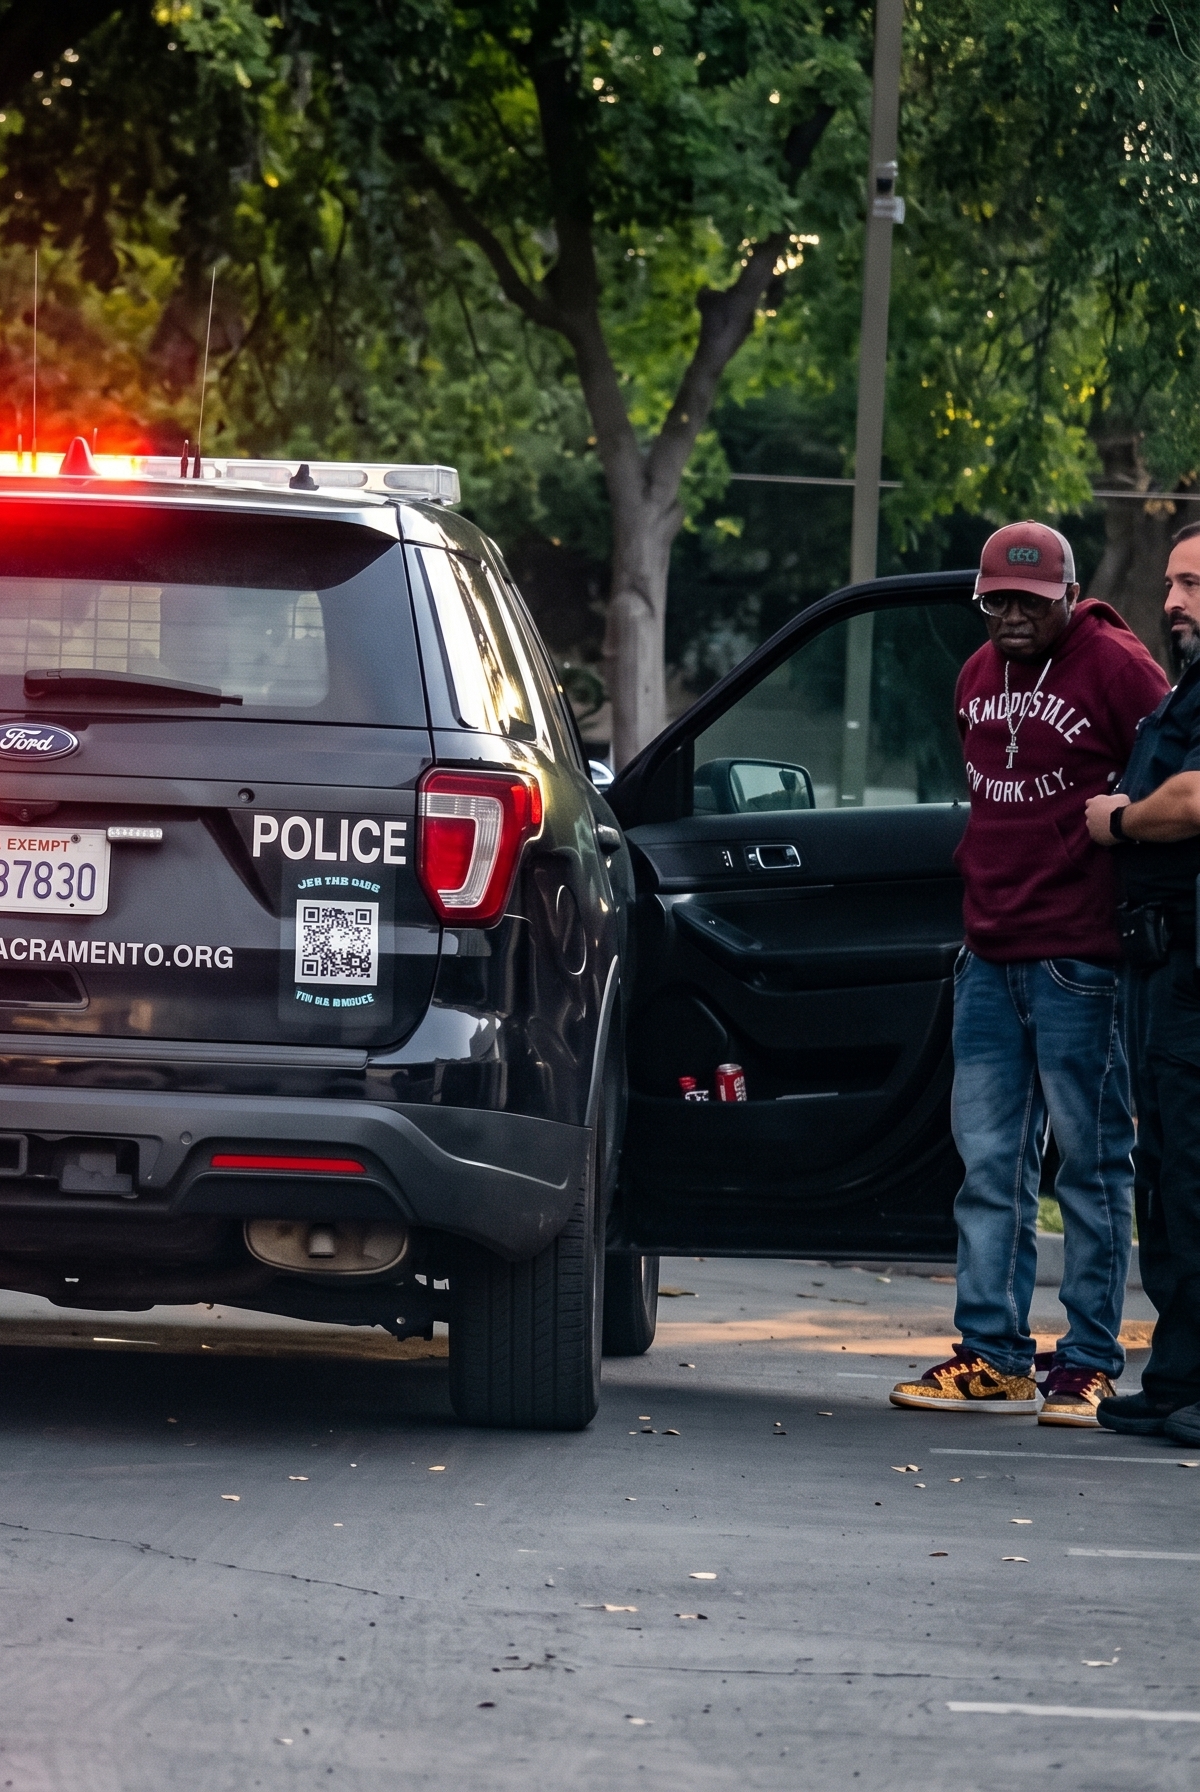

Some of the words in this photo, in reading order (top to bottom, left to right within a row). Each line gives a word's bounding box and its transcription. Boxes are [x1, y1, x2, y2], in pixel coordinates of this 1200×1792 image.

[0, 728, 54, 751] Ford
[7, 838, 71, 852] EXEMPT
[252, 814, 407, 865] POLICE
